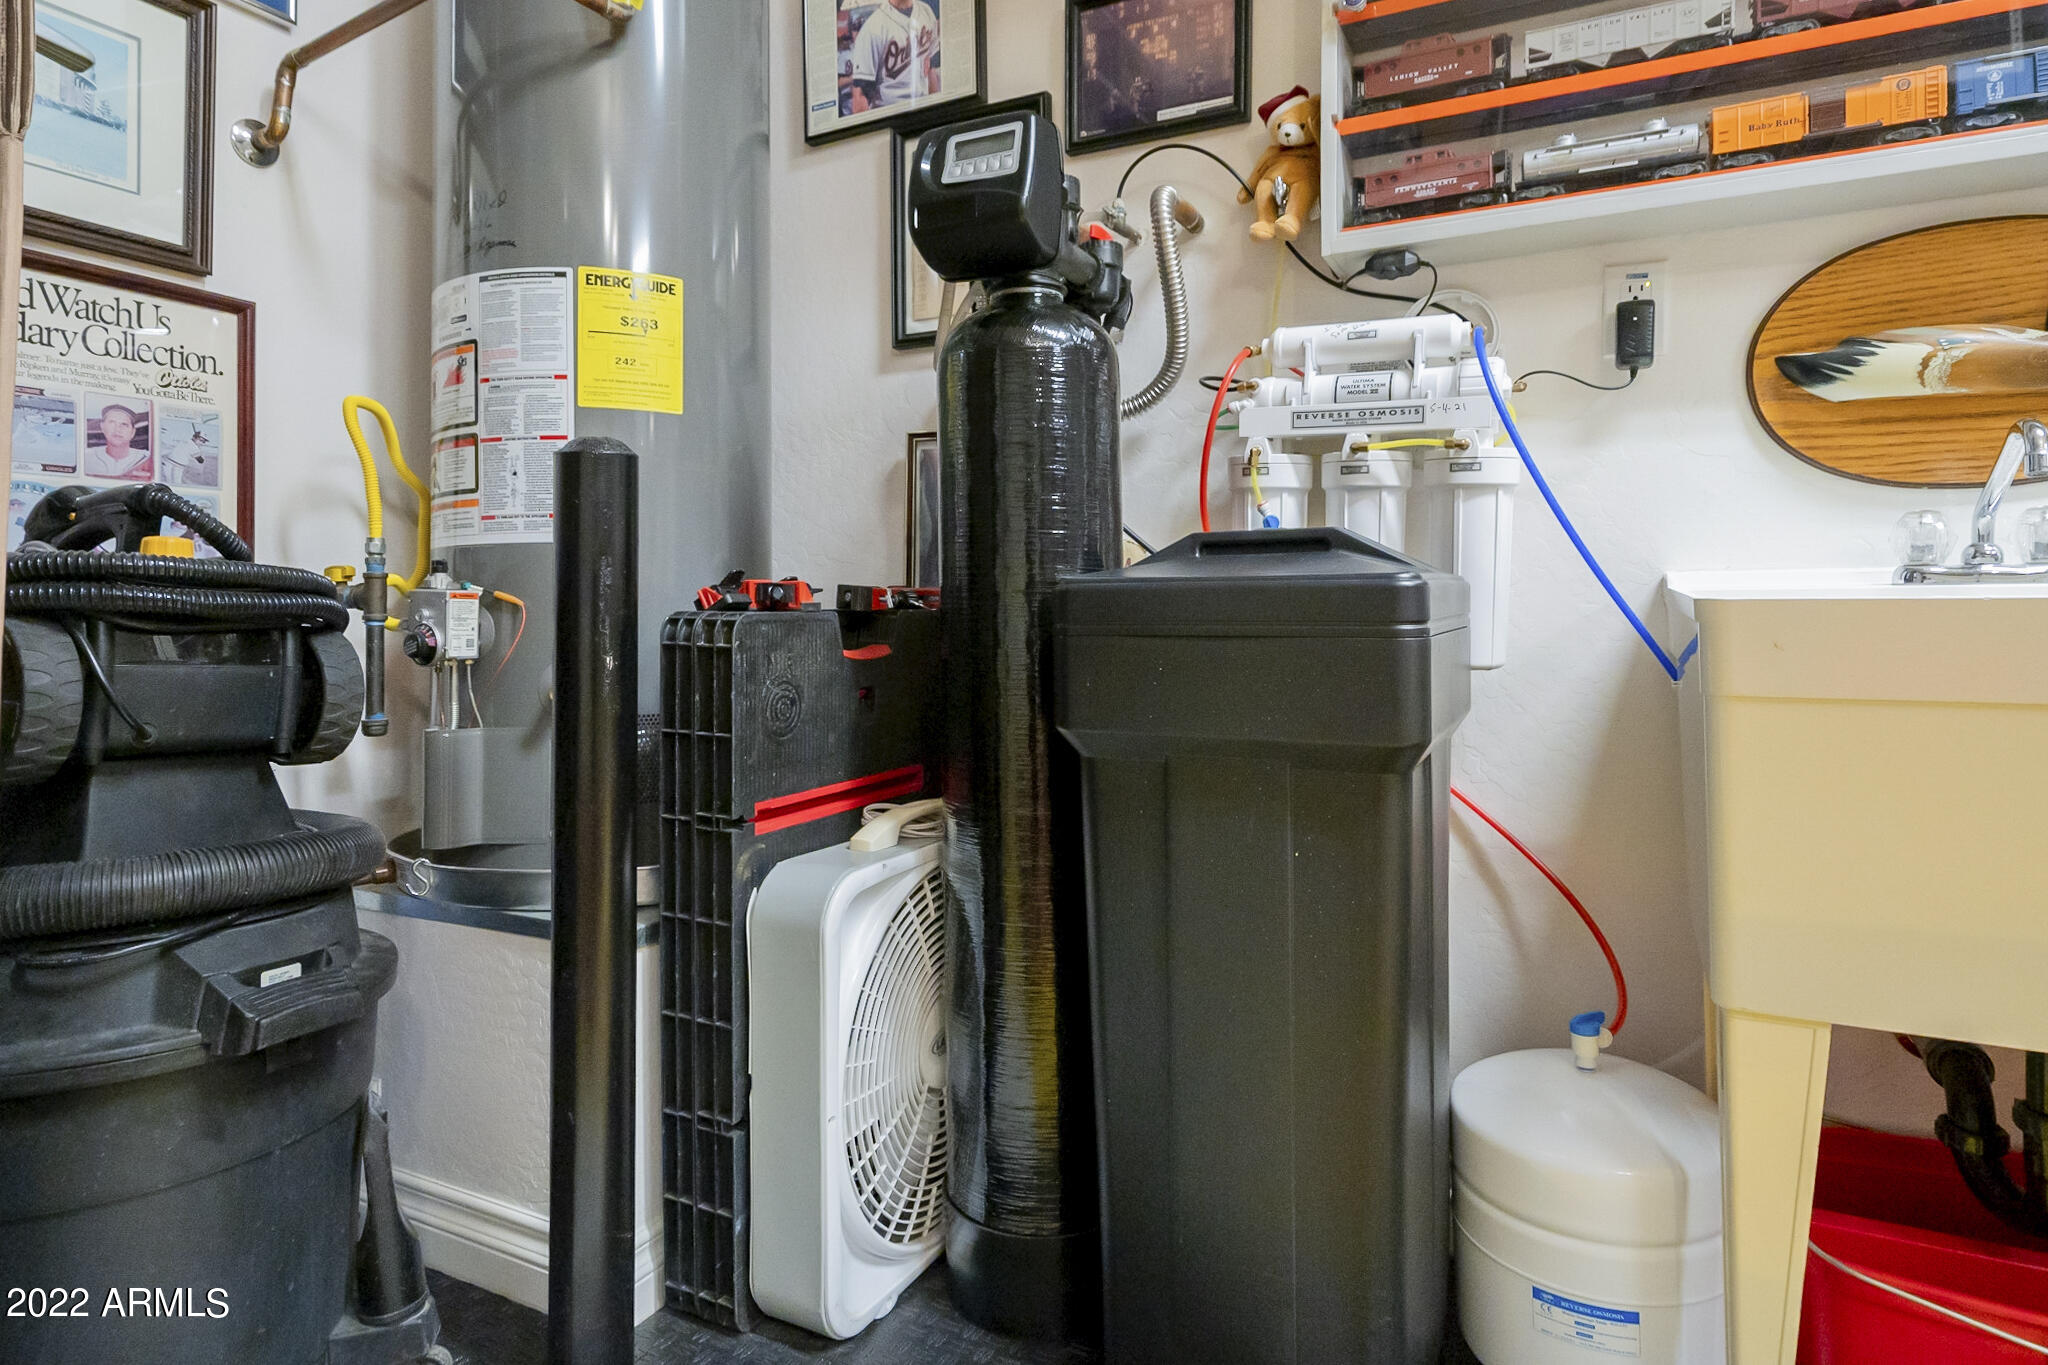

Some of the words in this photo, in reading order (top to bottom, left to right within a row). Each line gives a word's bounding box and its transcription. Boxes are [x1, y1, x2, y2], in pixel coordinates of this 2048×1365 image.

[1748, 122, 1774, 132] Baby
[1776, 117, 1802, 127] Ruth
[37, 280, 132, 329] Watch
[133, 299, 171, 336] Us
[81, 324, 224, 376] Collection.
[615, 356, 637, 366] 242
[132, 383, 149, 395] You
[1296, 412, 1350, 420] REVERSE
[1358, 408, 1421, 417] OSMOSIS
[1560, 1301, 1592, 1315] REVERSE
